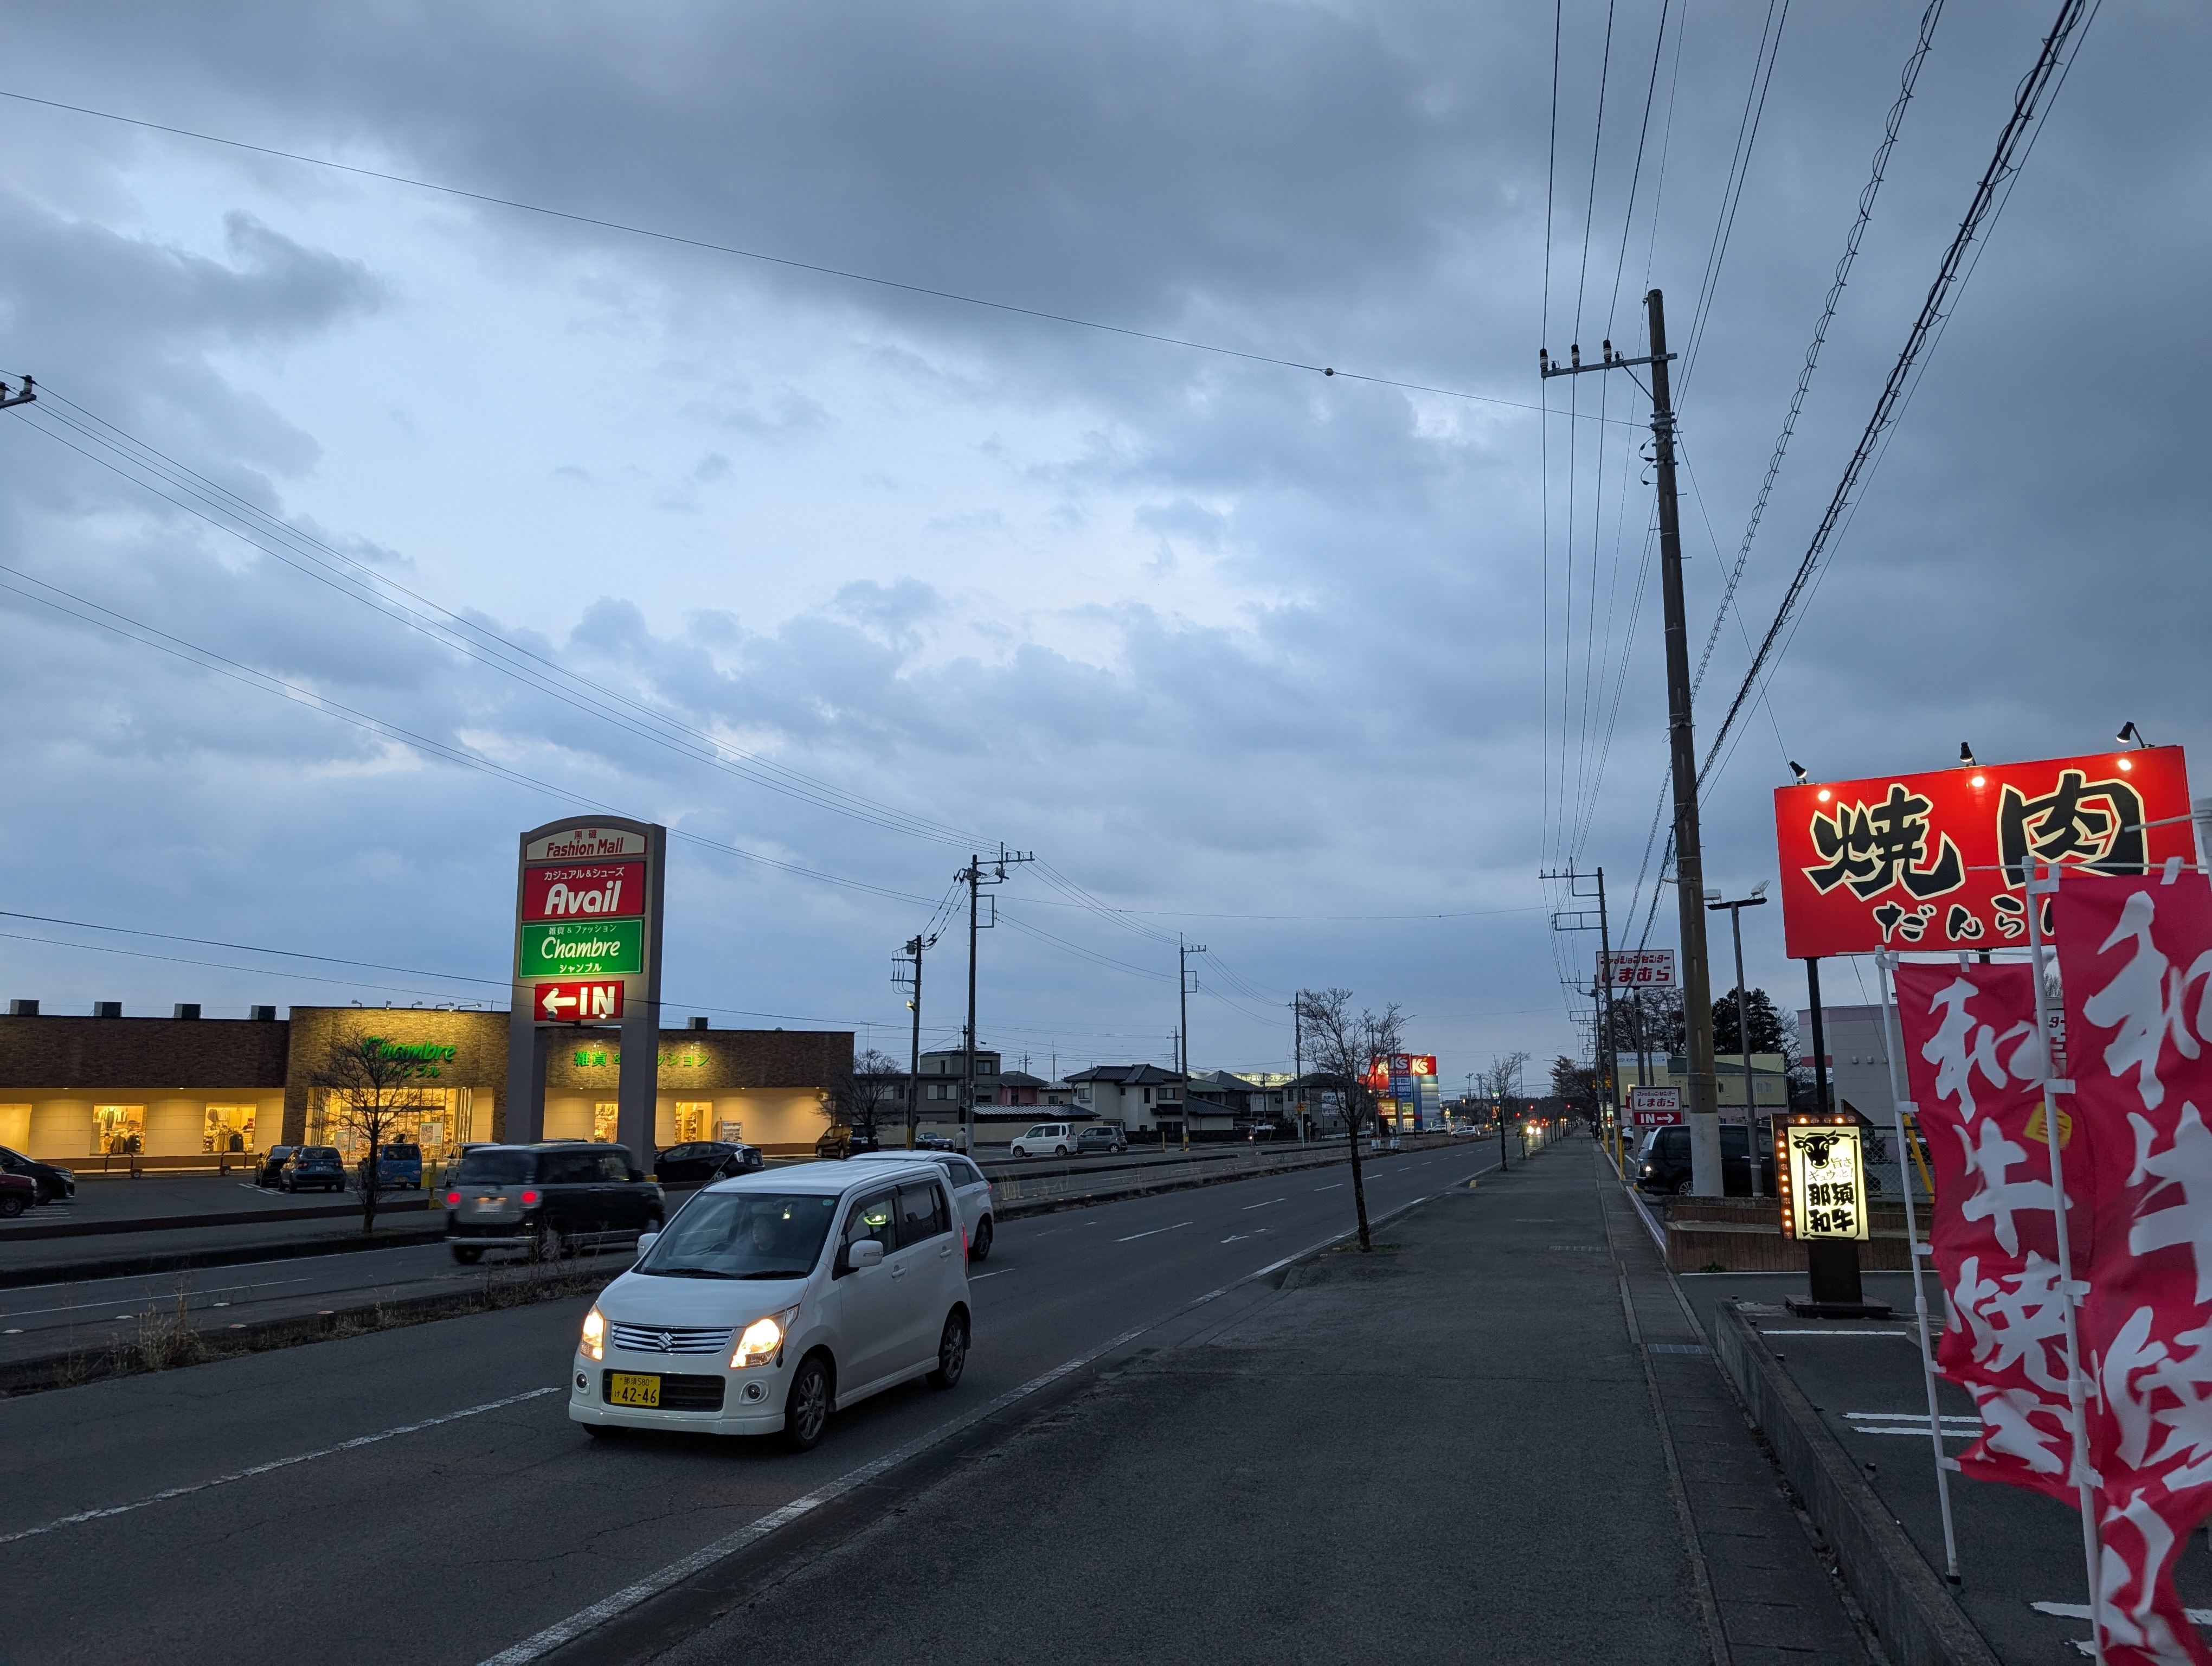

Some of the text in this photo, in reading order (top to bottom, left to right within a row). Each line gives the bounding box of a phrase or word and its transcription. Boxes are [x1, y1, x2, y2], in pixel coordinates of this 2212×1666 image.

[574, 830, 597, 840] 黒磯
[1802, 769, 2149, 901] 焼肉
[546, 837, 623, 857] Fashion Mall
[544, 867, 625, 881] カジュアル&シューズ
[544, 880, 622, 915] Avail
[1873, 894, 2055, 944] だんら
[542, 937, 621, 959] Chambre
[560, 963, 602, 973] シャンブル
[1602, 966, 1670, 982] しまむら
[580, 986, 615, 1015] IN
[1638, 1098, 1676, 1107] しまむら
[1641, 1114, 1655, 1124] IN
[1831, 1157, 1852, 1169] 旨さ
[1808, 1168, 1854, 1182] ギュウっと!
[1808, 1181, 1855, 1206] 那須
[1808, 1208, 1855, 1232] 和牛
[622, 1387, 657, 1404] 42-46
